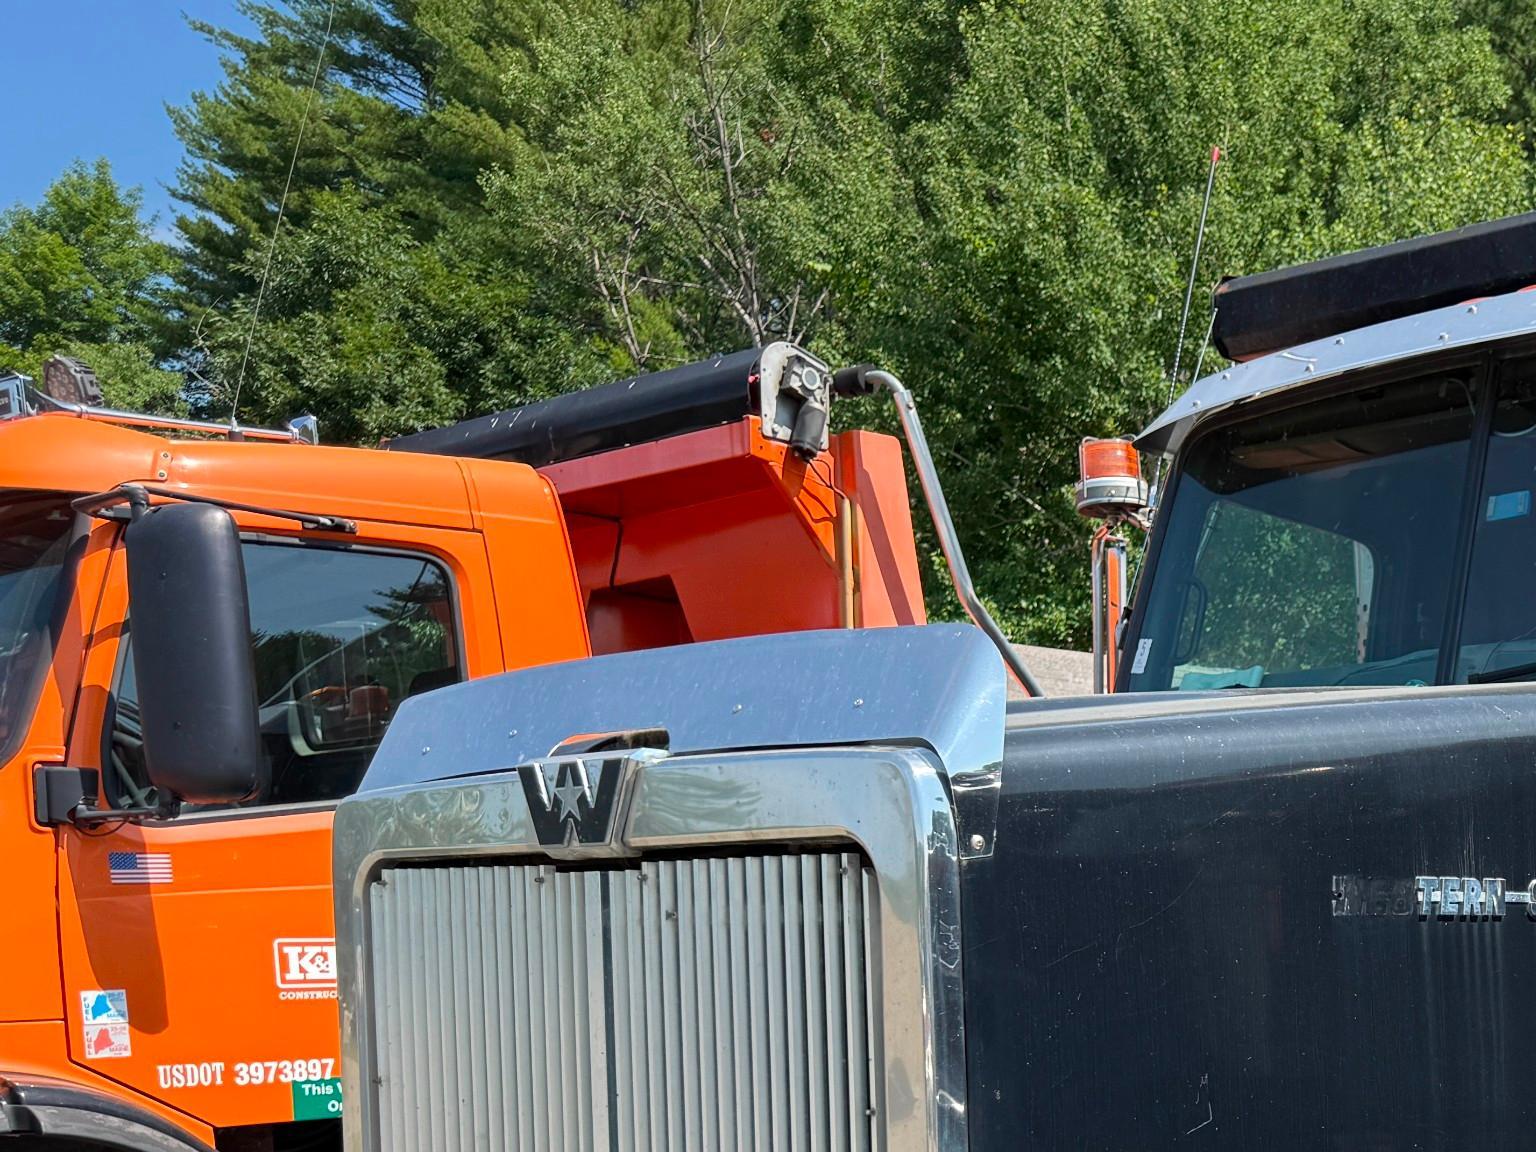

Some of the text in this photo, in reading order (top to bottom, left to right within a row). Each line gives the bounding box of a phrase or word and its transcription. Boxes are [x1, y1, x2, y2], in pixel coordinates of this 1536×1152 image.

[283, 945, 337, 981] K&
[157, 1058, 335, 1089] USDOT 3973897
[301, 1083, 334, 1096] This
